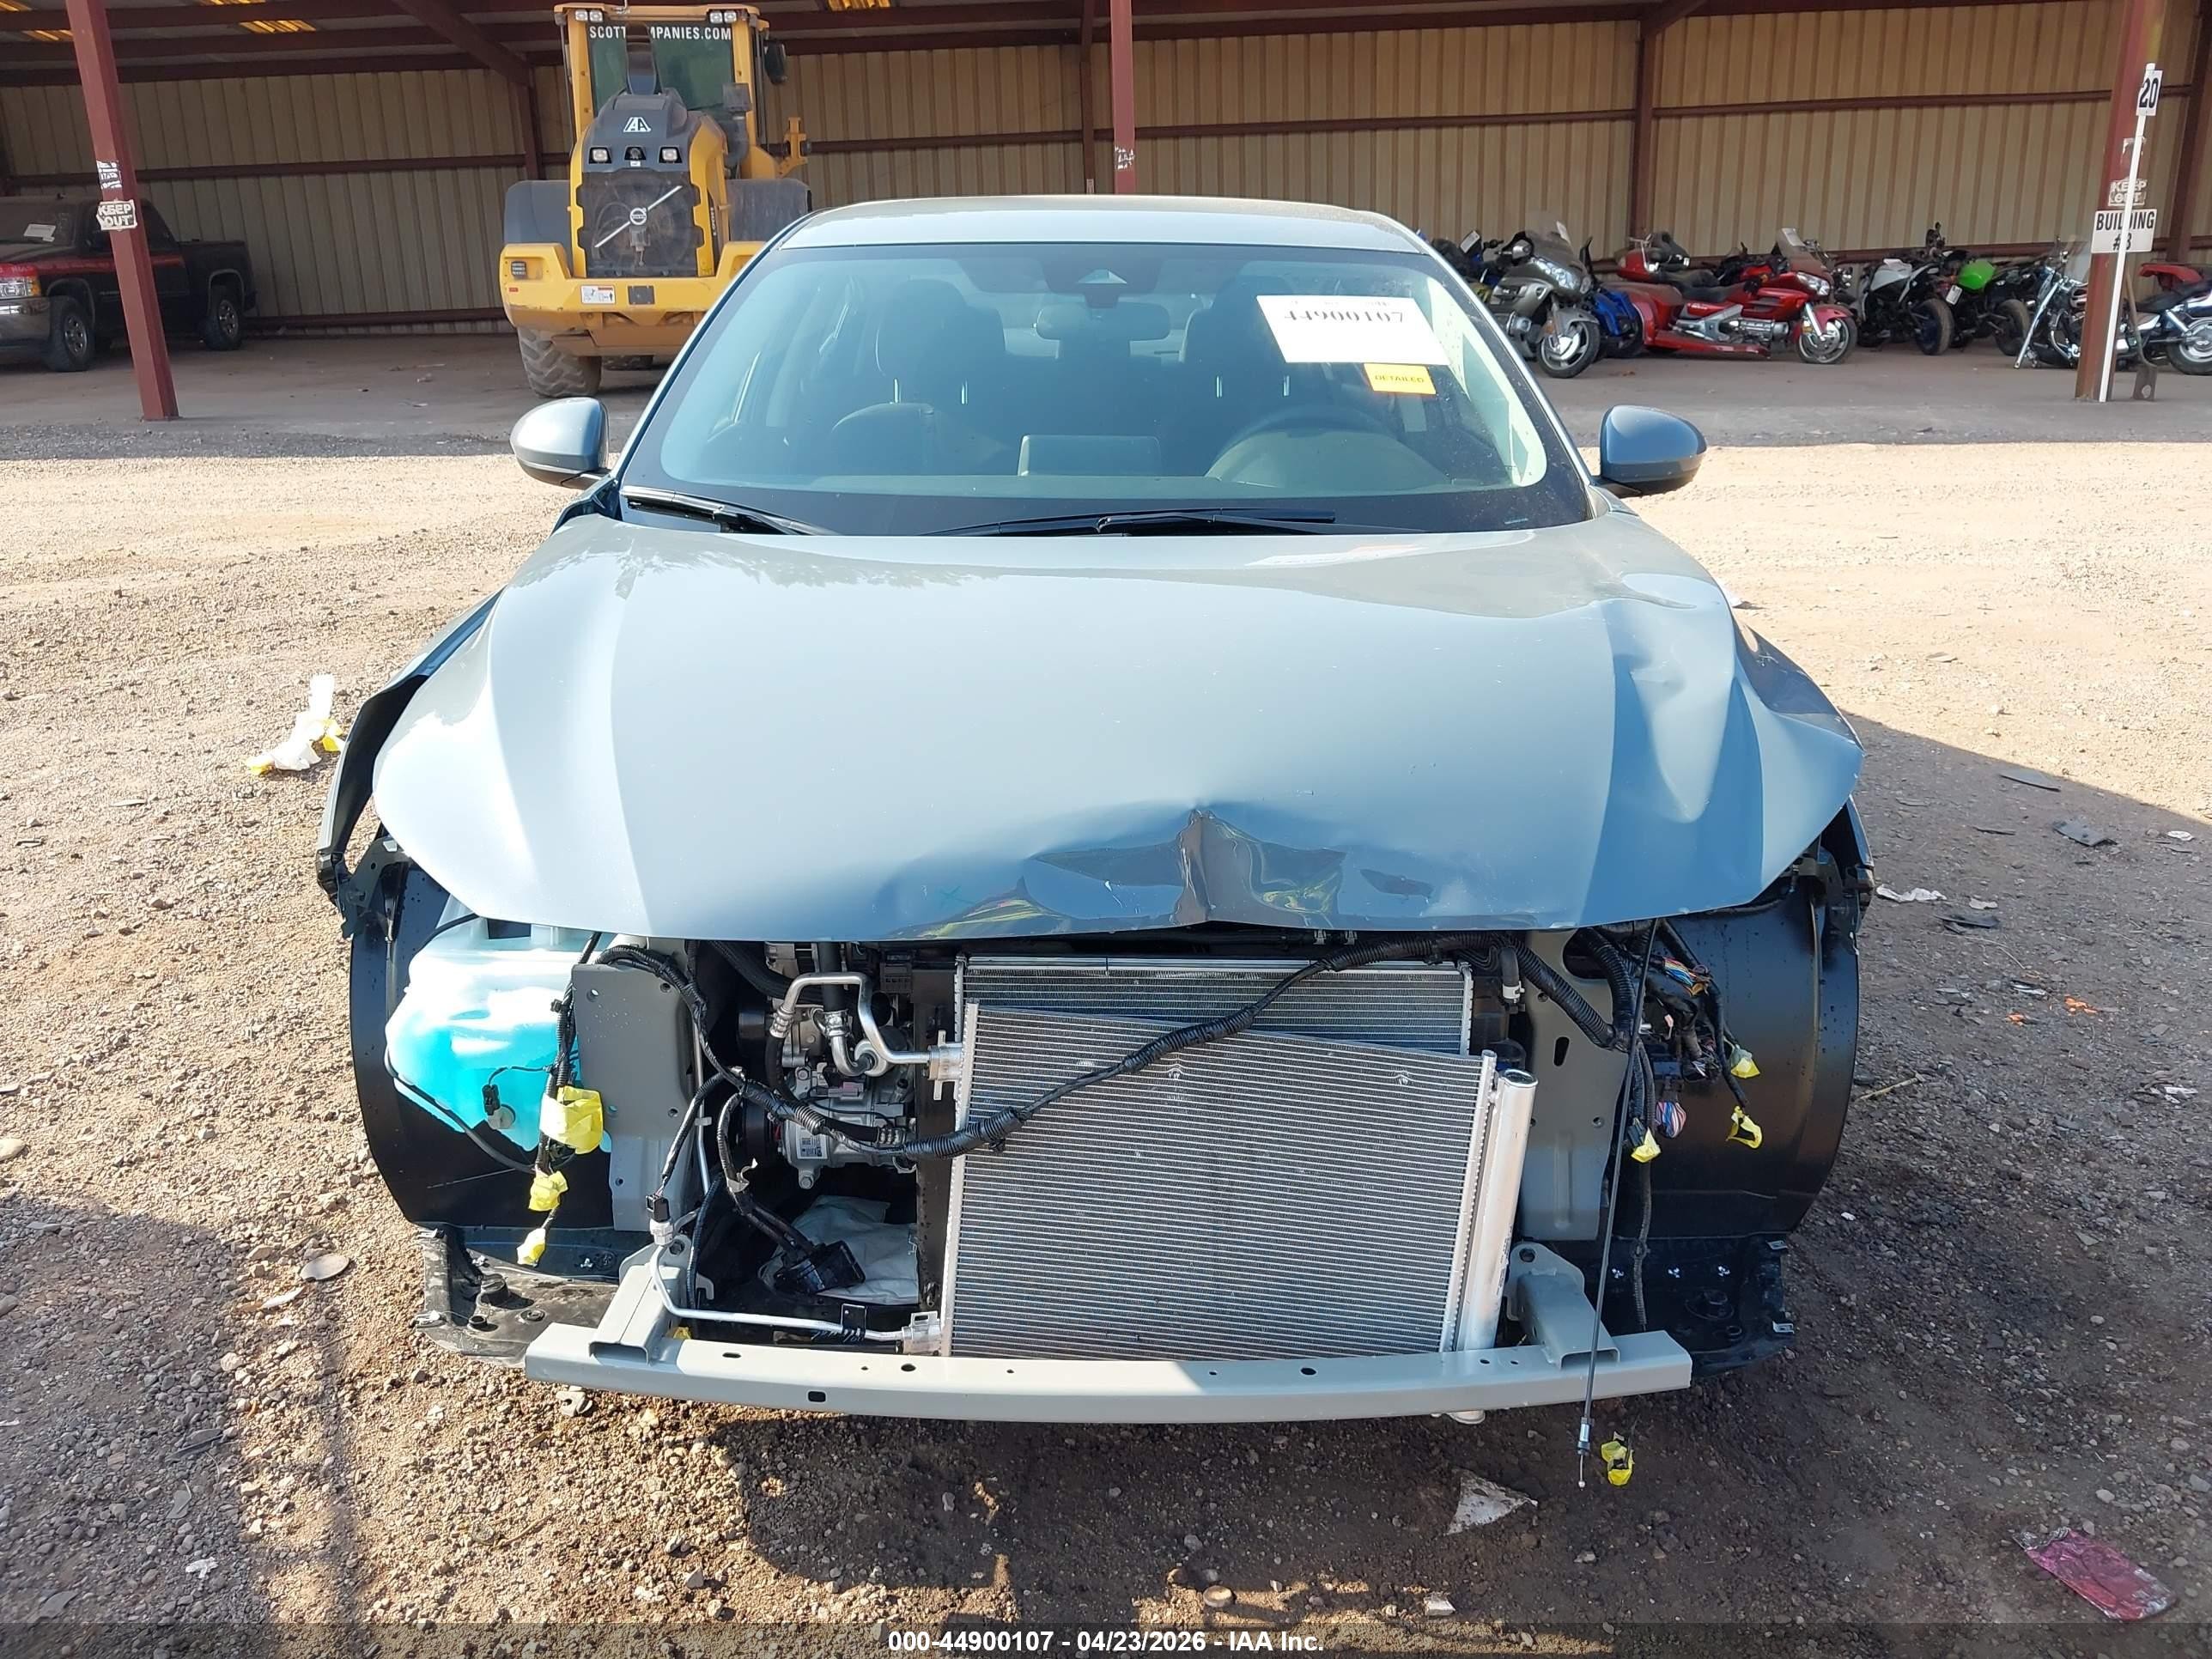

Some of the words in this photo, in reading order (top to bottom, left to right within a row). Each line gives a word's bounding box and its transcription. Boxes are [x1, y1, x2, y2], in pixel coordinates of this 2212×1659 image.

[589, 26, 626, 39] SCOTT
[2139, 77, 2159, 108] 20
[2110, 180, 2147, 192] KEP
[98, 204, 131, 216] KEEP
[104, 215, 132, 227] OUT
